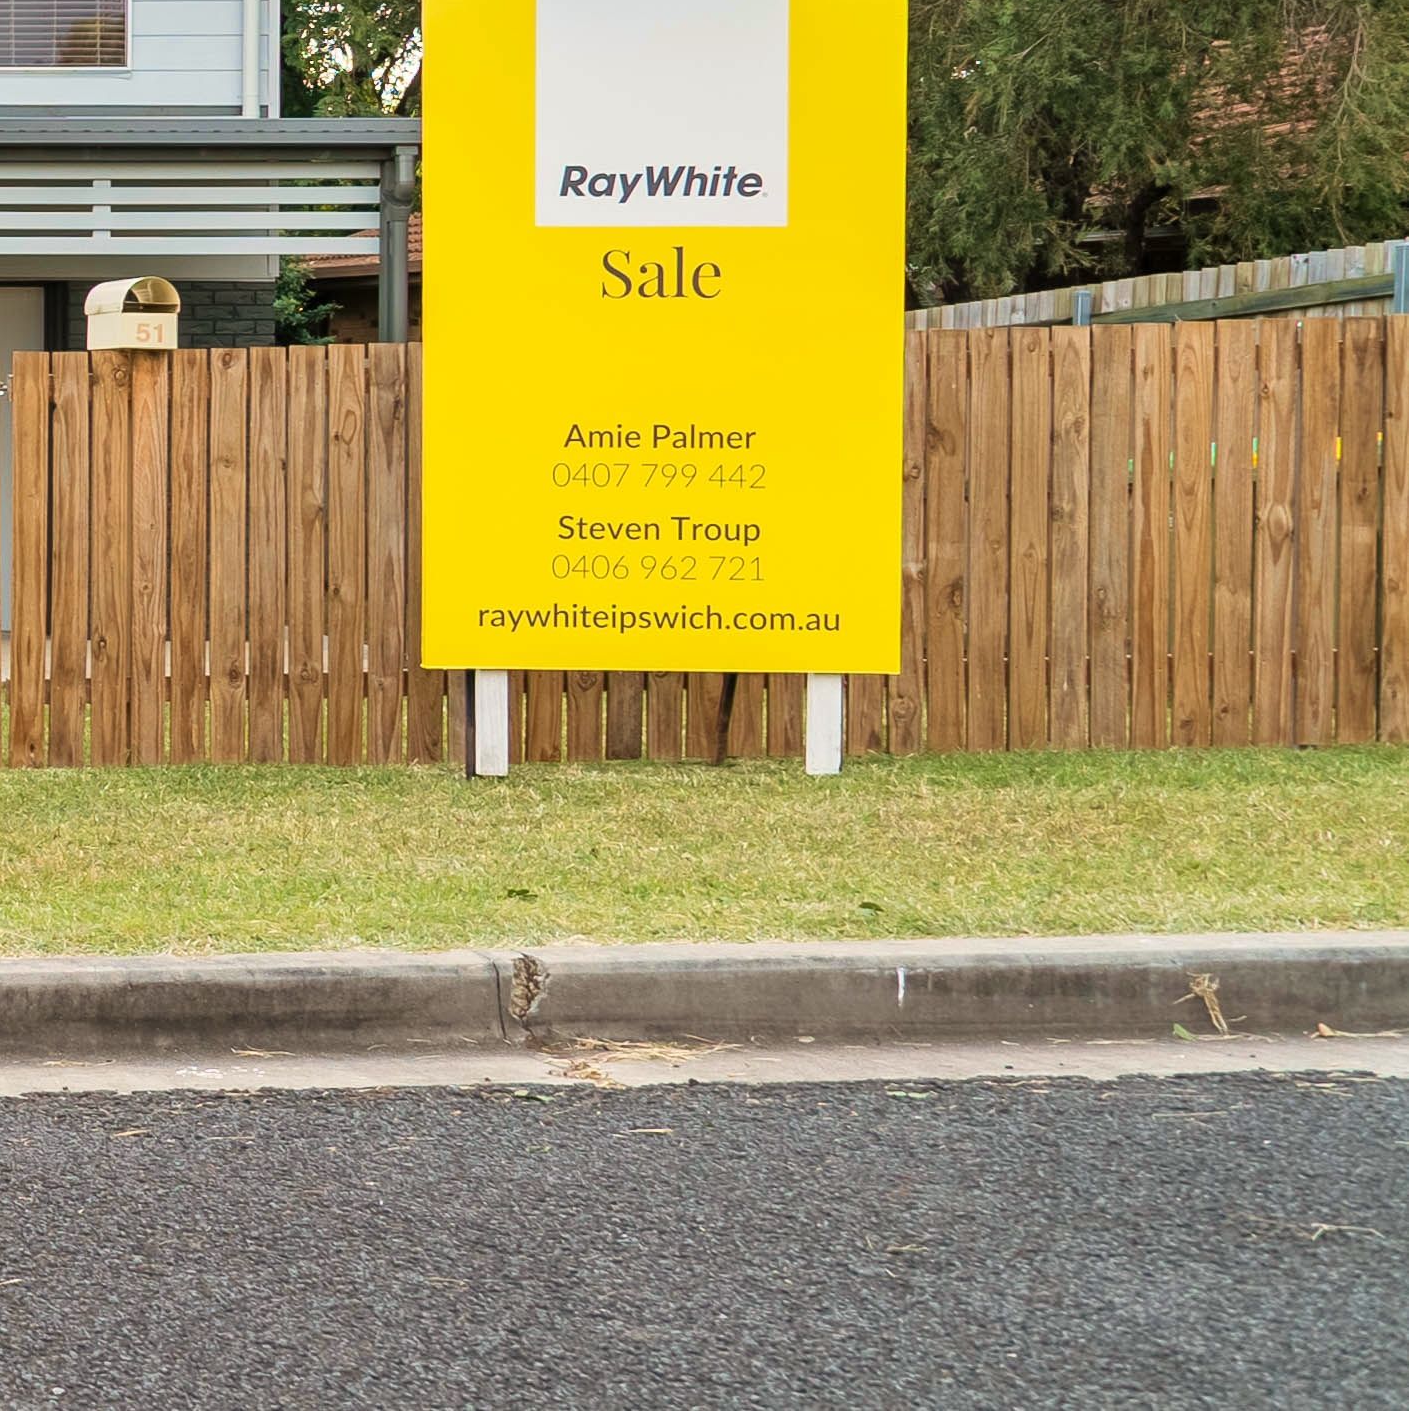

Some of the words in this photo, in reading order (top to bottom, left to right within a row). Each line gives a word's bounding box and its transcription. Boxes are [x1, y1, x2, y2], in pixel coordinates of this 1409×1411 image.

[600, 244, 723, 301] Sale
[136, 323, 164, 344] 51
[563, 422, 641, 450] Amie
[651, 423, 757, 451] Palmer
[551, 461, 630, 488] 0407
[641, 462, 698, 488] 799
[708, 463, 766, 490] 442
[558, 514, 661, 541] Steven
[670, 515, 762, 547] Troup
[550, 554, 630, 580] 0406
[639, 555, 697, 581] 962
[709, 555, 765, 581] 721
[478, 602, 841, 635] raywhiteipswich.com.au
